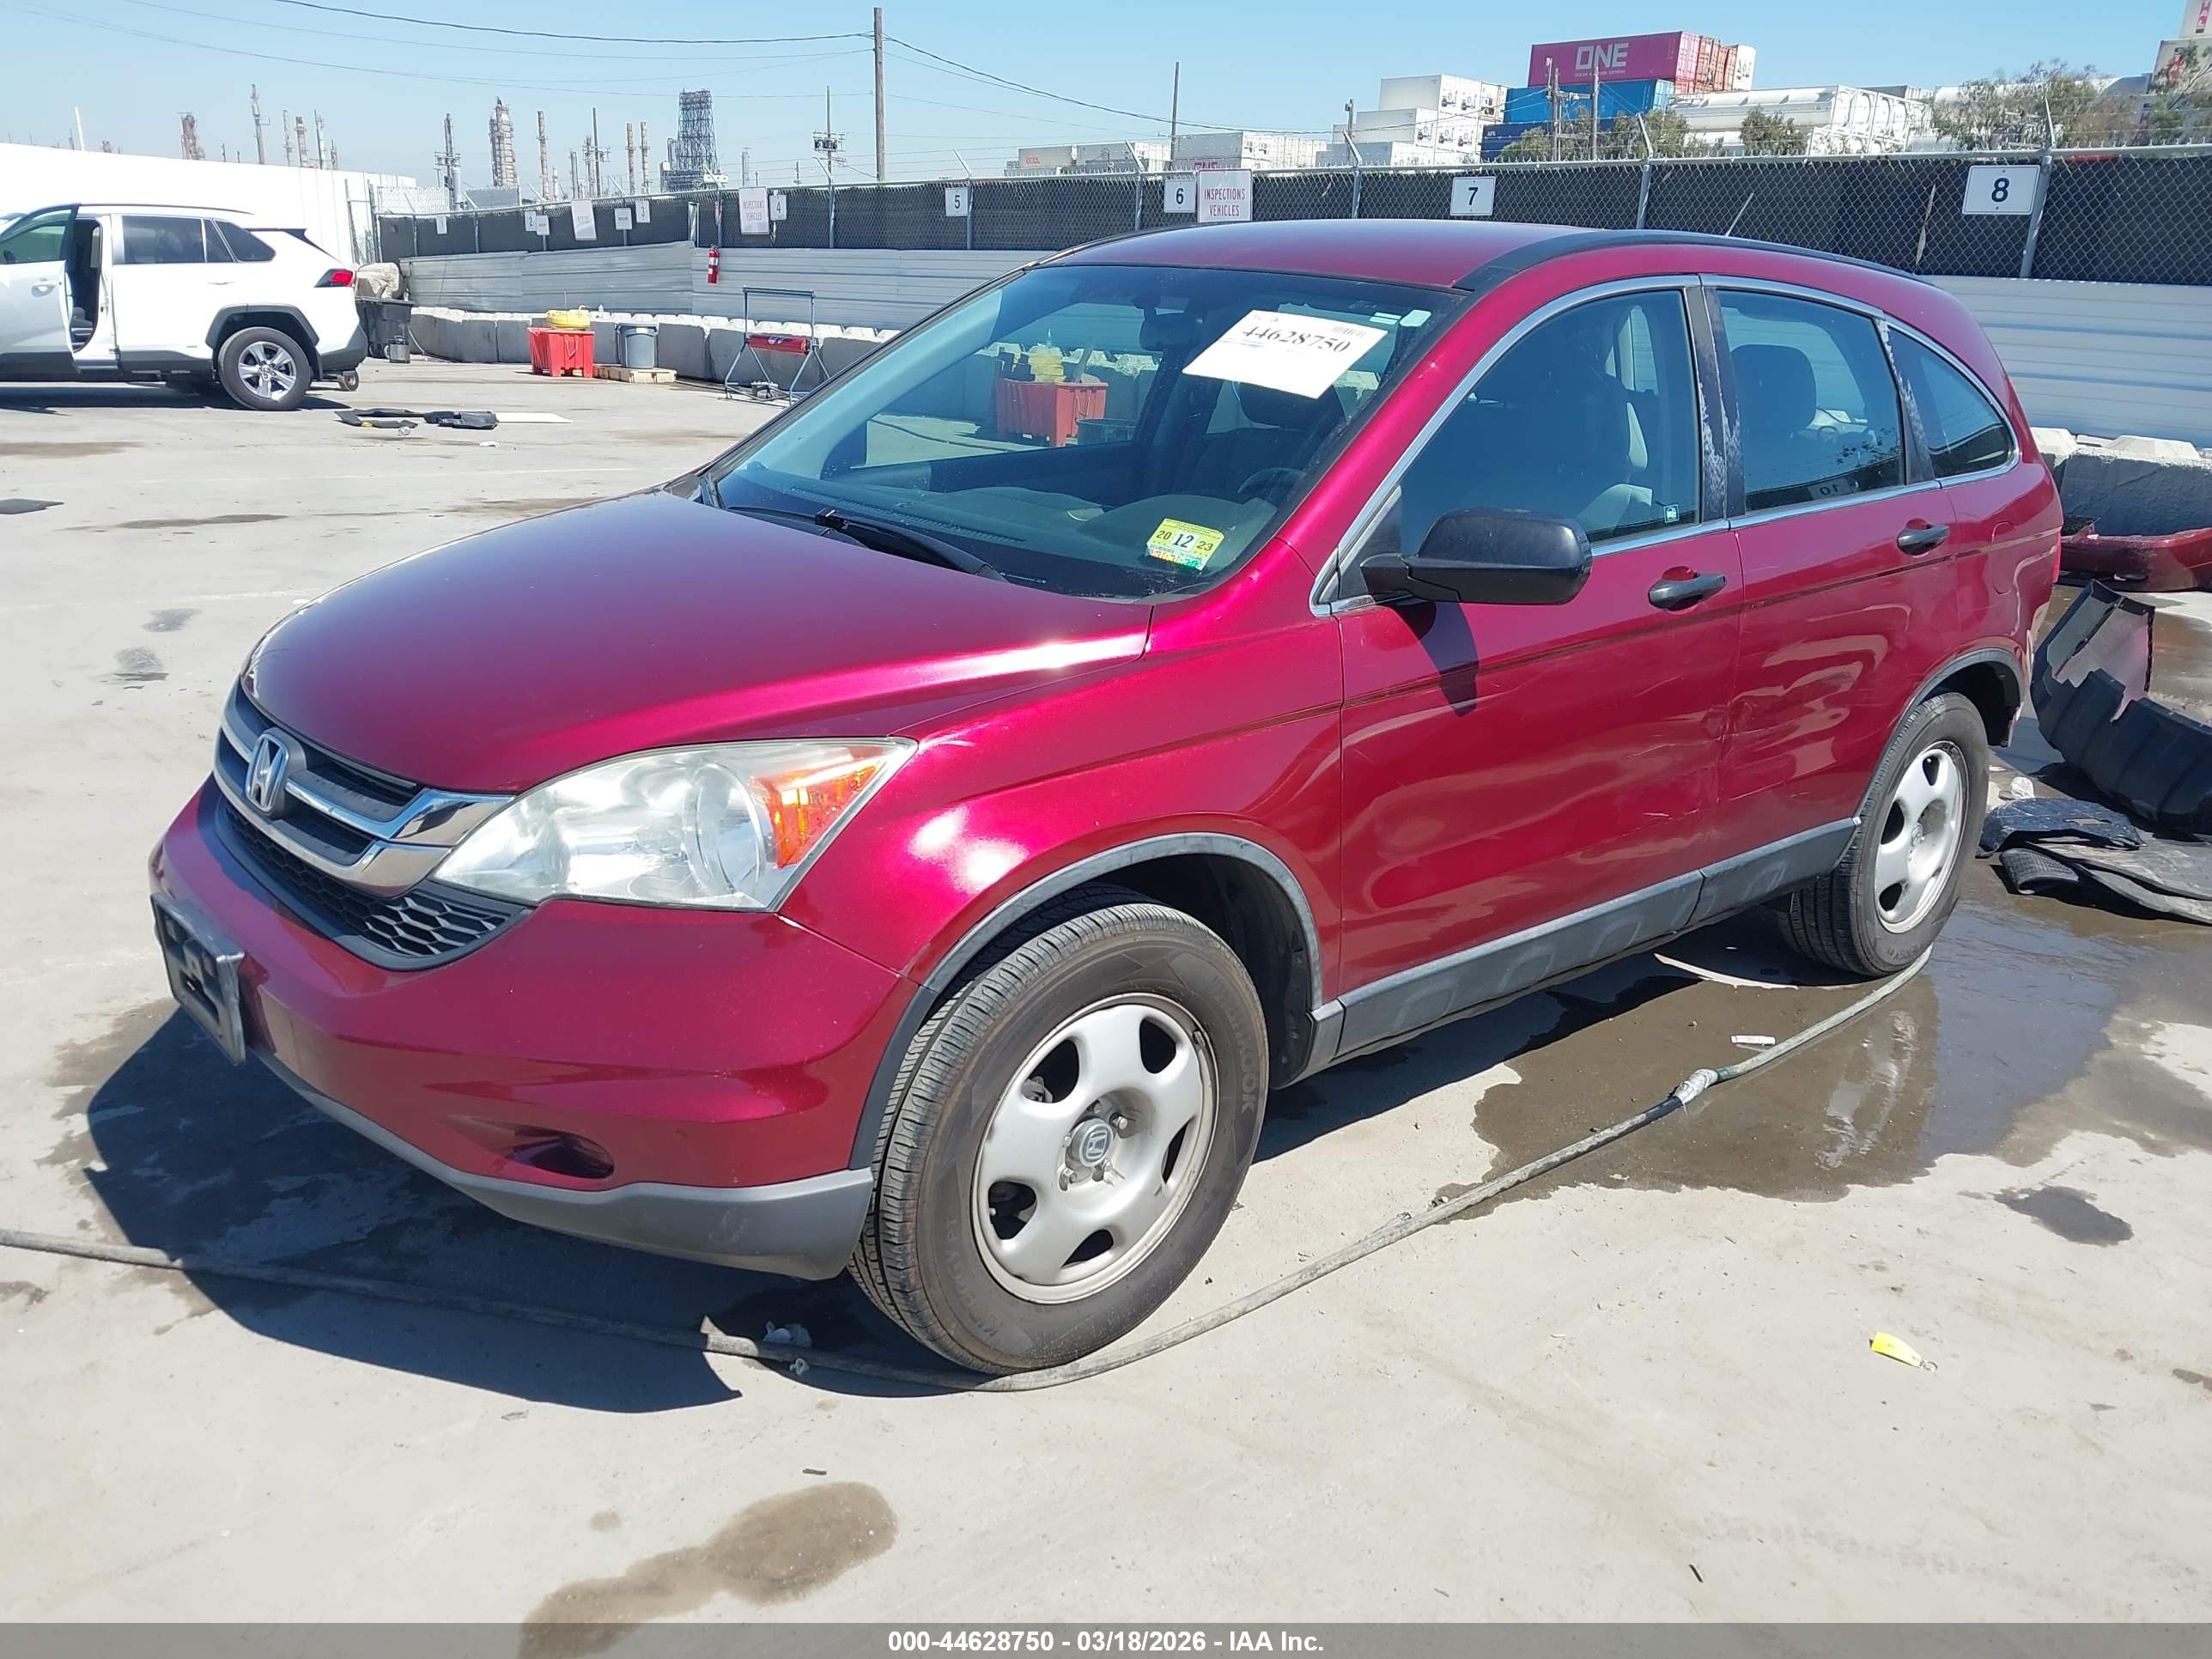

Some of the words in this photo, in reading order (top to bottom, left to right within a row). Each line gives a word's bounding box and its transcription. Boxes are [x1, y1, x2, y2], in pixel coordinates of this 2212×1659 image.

[1575, 43, 1629, 70] ONE
[1176, 187, 1184, 204] 6
[1204, 188, 1245, 200] INSPECTIONS
[1468, 186, 1479, 206] 7
[1991, 177, 2010, 203] 8
[775, 201, 781, 214] 4
[954, 194, 961, 210] 5
[641, 205, 646, 218] 3
[1209, 204, 1240, 217] VEHICLES
[529, 216, 533, 227] 2
[1242, 325, 1351, 353] 44628750
[1156, 530, 1172, 540] 20
[1172, 533, 1194, 549] 12
[1196, 540, 1213, 551] 23
